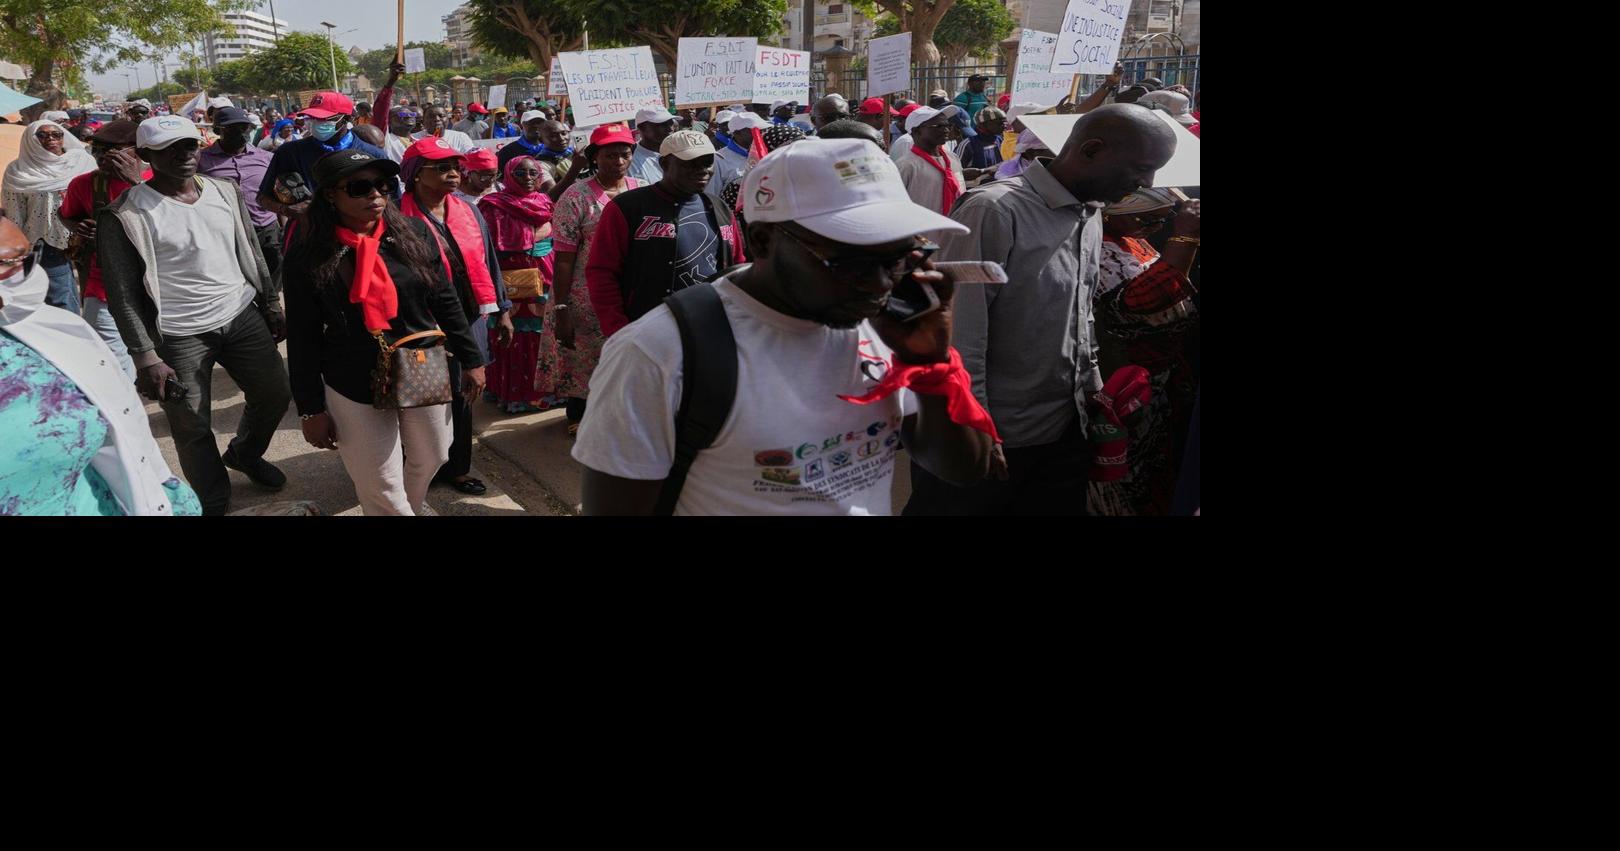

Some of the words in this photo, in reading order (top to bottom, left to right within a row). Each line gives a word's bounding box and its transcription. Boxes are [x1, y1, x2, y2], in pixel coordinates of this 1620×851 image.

[760, 51, 801, 68] FSDT
[1059, 39, 1111, 66] SOCIAL
[566, 72, 584, 85] LES
[704, 76, 737, 88] FORCE
[578, 86, 622, 102] PLAIDENT
[585, 102, 636, 119] JUSTICE
